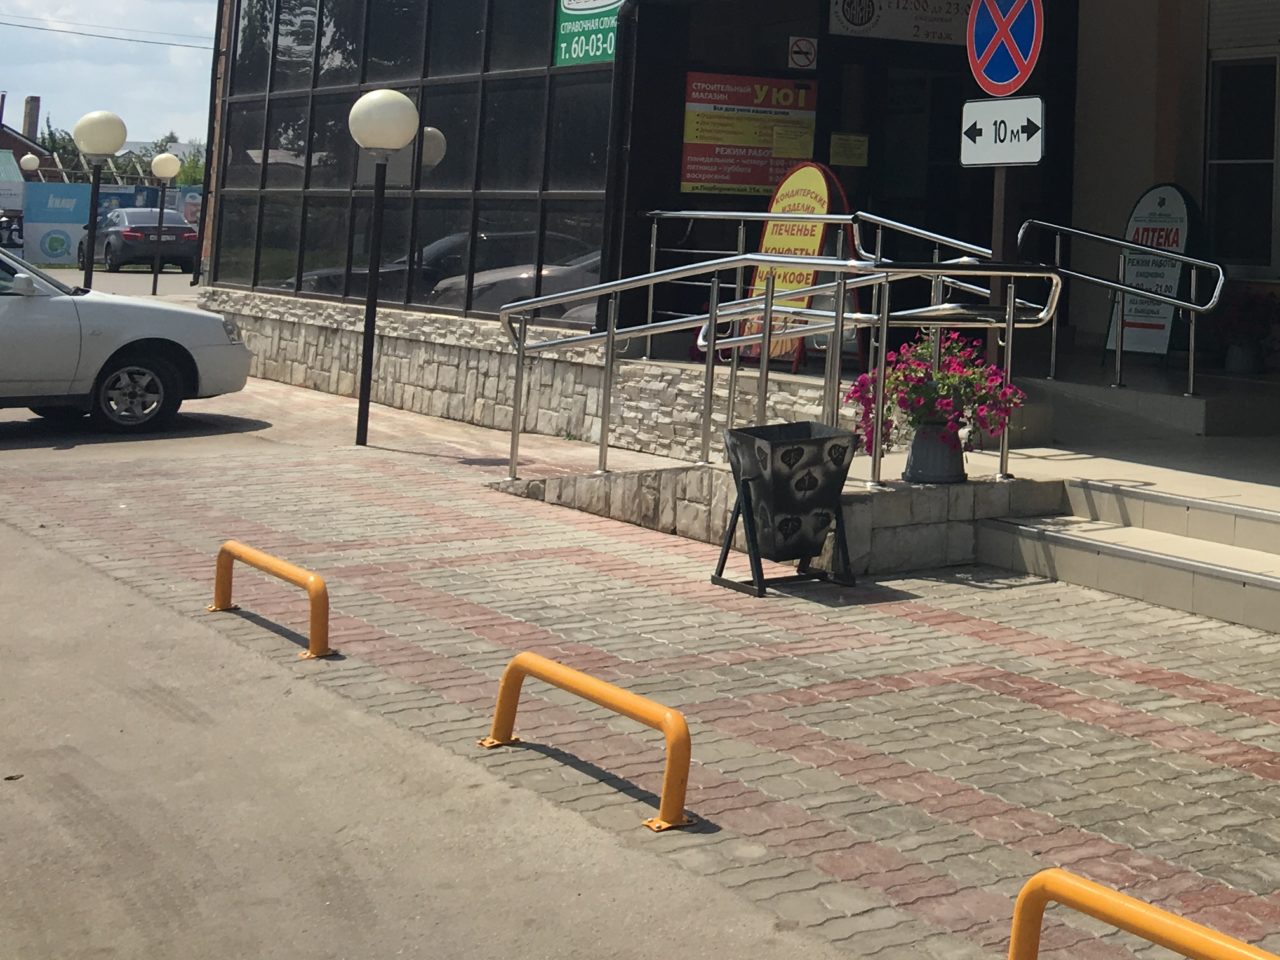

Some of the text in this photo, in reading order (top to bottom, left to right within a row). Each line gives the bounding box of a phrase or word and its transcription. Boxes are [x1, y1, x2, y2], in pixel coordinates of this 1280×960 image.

[944, 1, 971, 16] 23:0
[560, 18, 599, 34] СПРАВОЧНАЯ
[913, 25, 953, 41] 2 этаж
[571, 32, 616, 58] 60-03-0
[692, 82, 753, 94] СТРОИТЕЛЬНЫЙ
[691, 91, 729, 101] МАГАЗИН
[993, 120, 1020, 144] 10 м
[715, 146, 747, 156] РЕЖИМ
[775, 188, 828, 209] КОНДИТЕРСКИЕ
[782, 202, 816, 215] ИЗДЕЛИЯ
[771, 223, 818, 237] ПЕЧЕНЬЕ
[1132, 227, 1180, 247] АПТЕКА
[1127, 257, 1151, 267] РЕЖИМ
[781, 271, 812, 285] КОФЕ
